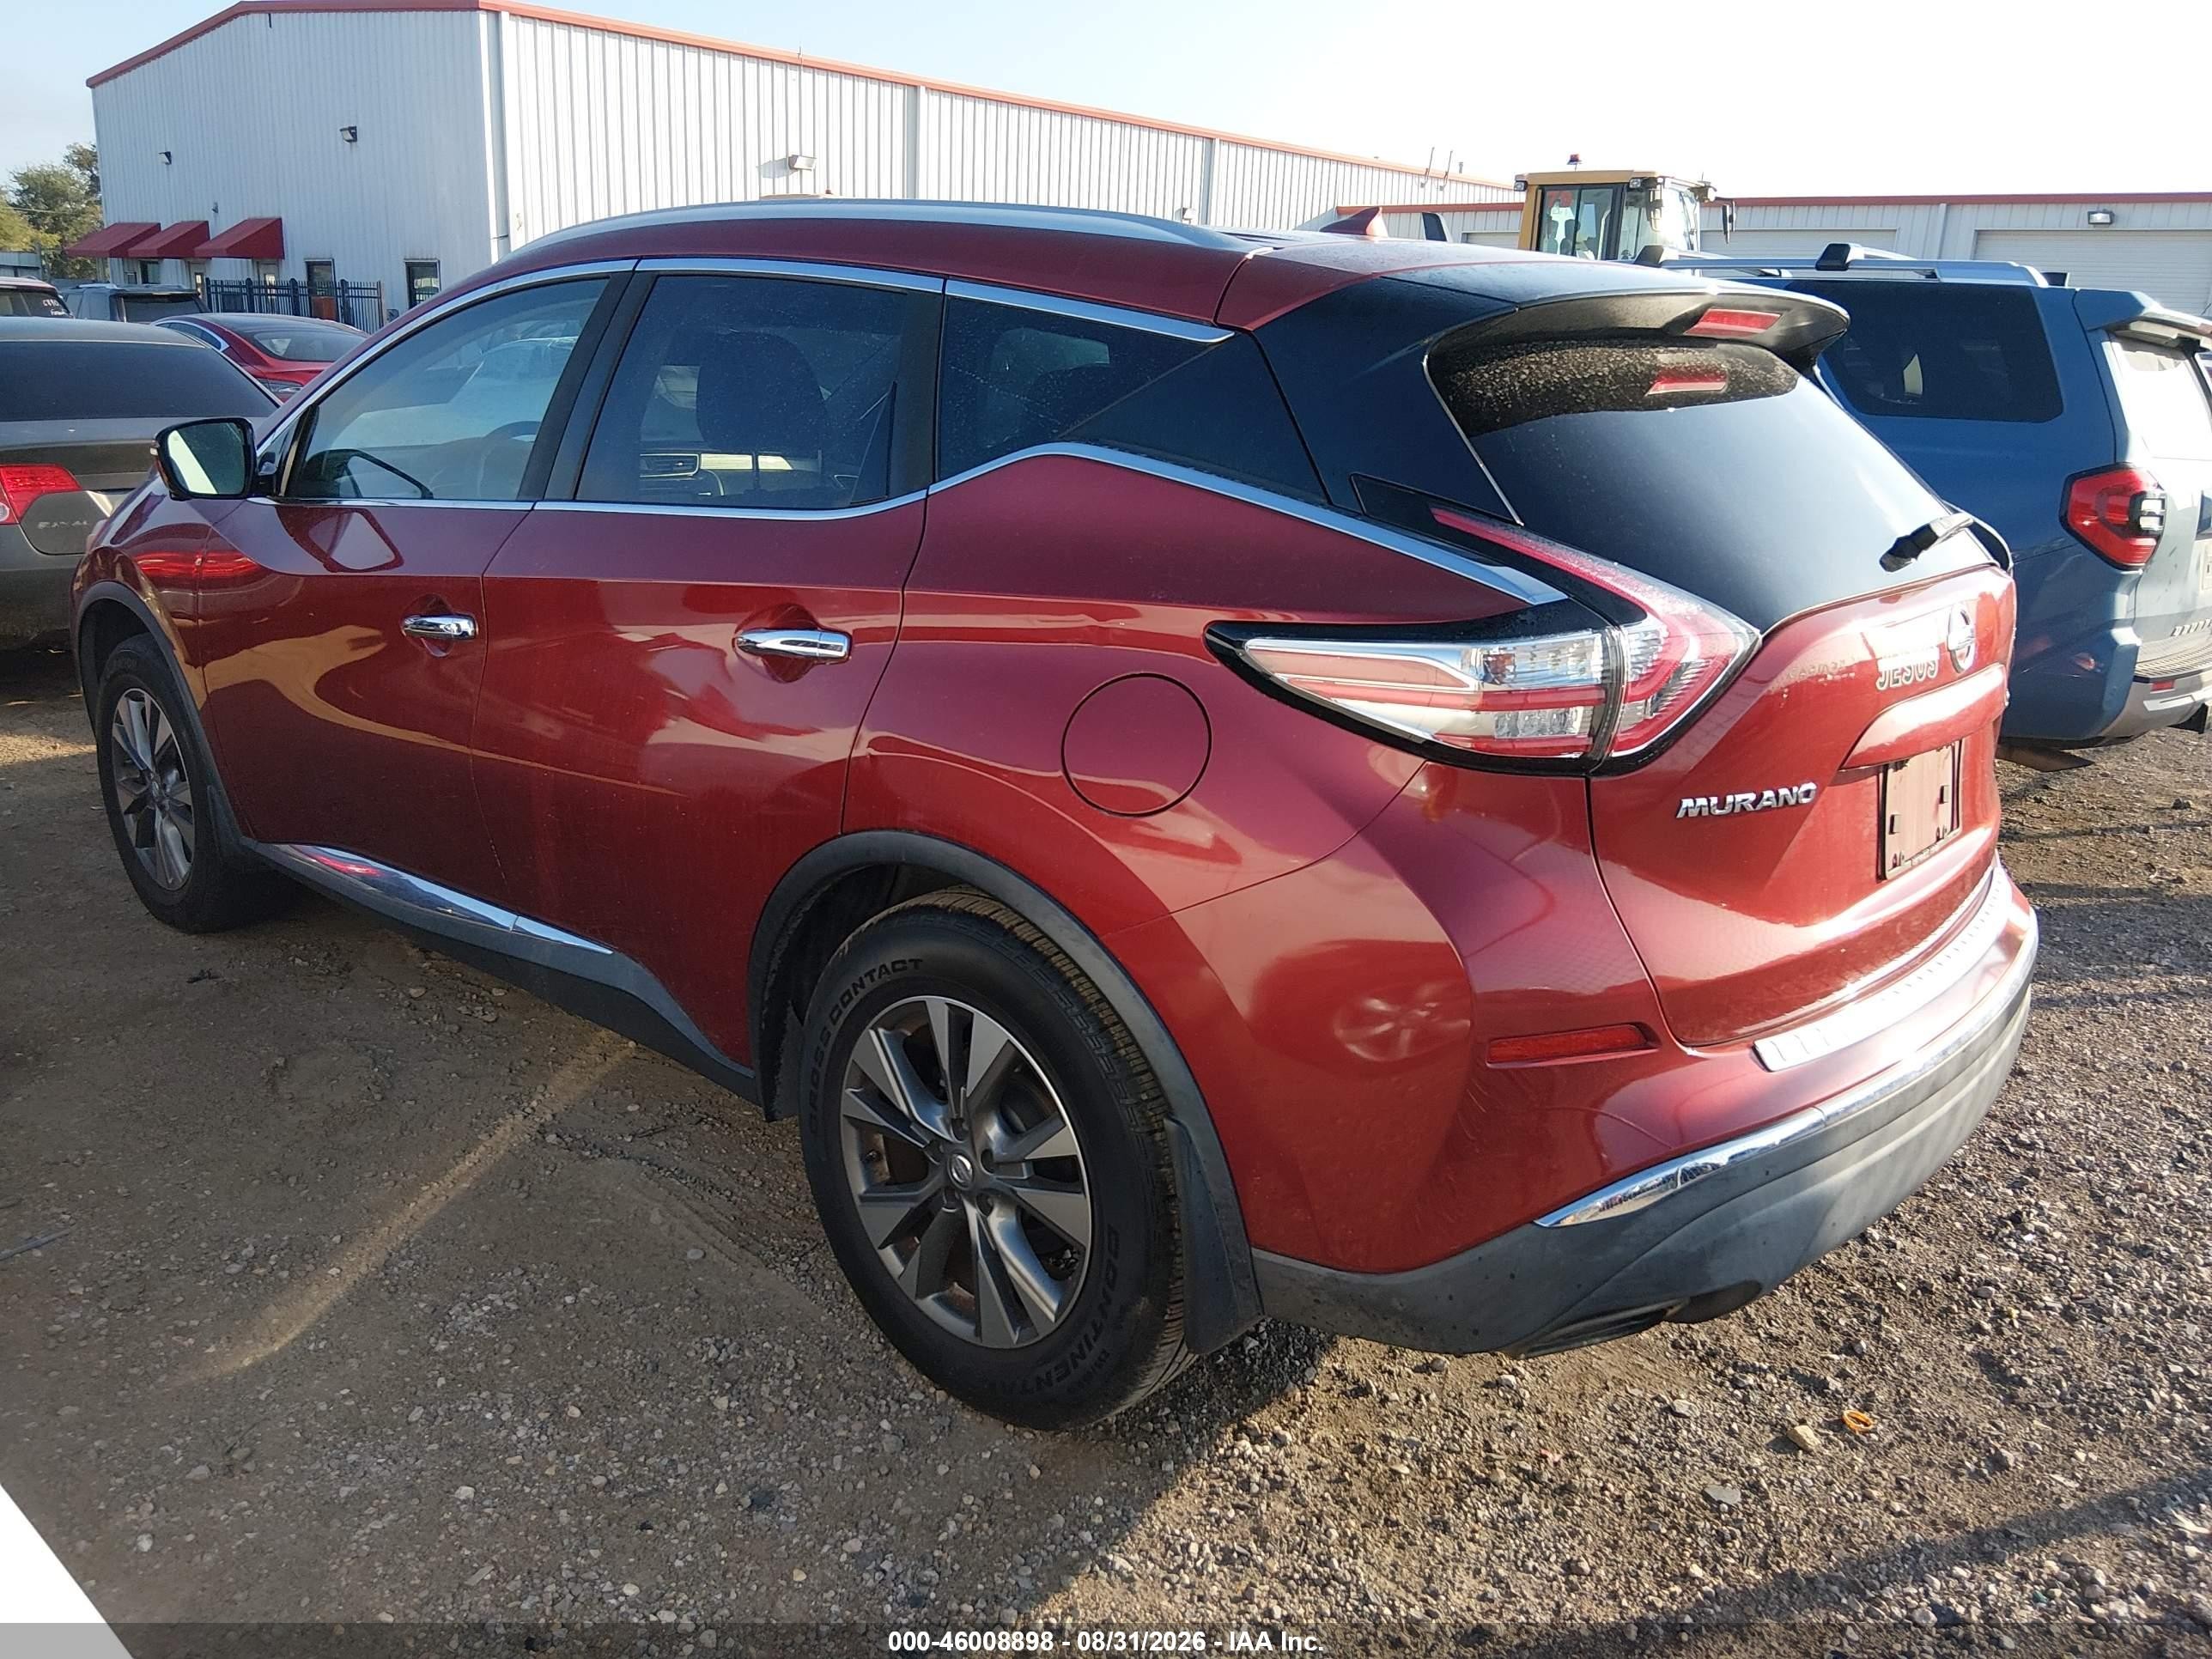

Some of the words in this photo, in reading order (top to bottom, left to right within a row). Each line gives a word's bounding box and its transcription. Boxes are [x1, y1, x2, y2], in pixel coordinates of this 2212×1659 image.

[1875, 659, 1939, 690] JESUS
[1675, 781, 1818, 818] MURANO
[829, 957, 924, 1026] CONTACT
